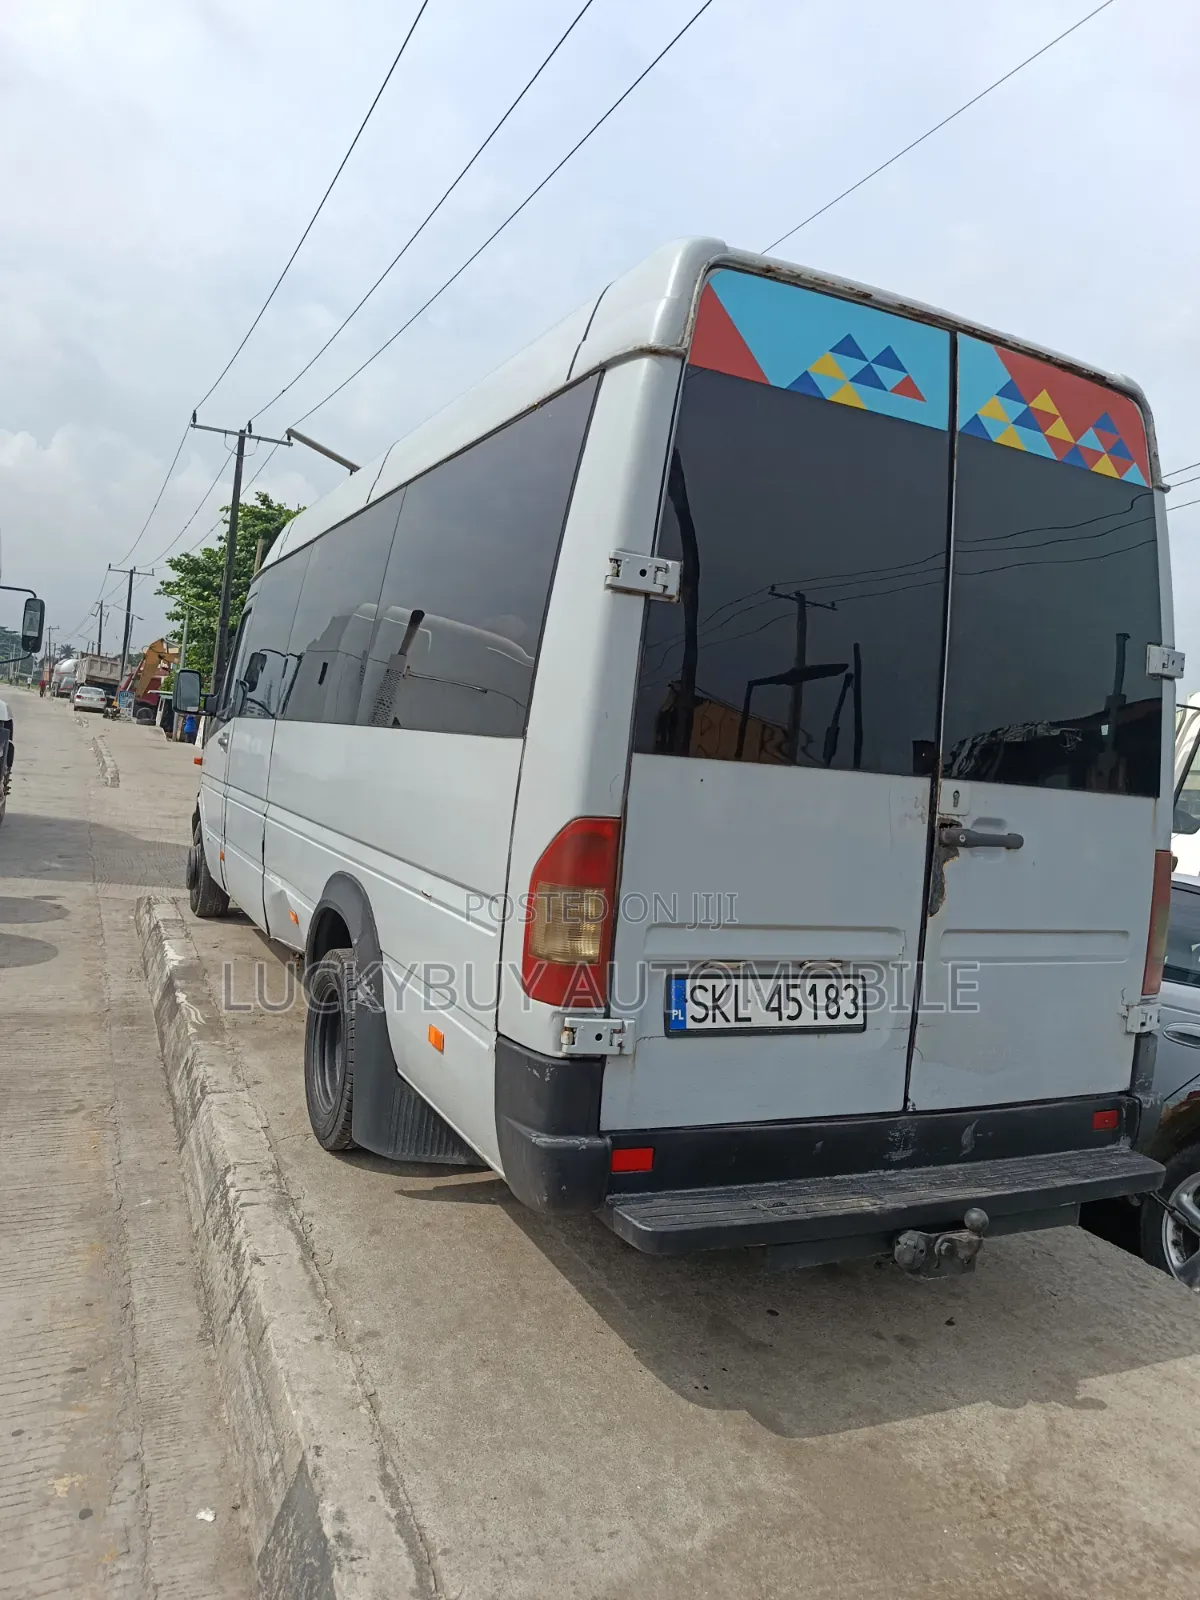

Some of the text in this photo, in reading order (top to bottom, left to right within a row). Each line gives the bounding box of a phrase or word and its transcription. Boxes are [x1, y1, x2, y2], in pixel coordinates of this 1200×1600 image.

[671, 1009, 684, 1021] PL
[689, 983, 859, 1023] SKL 45183
